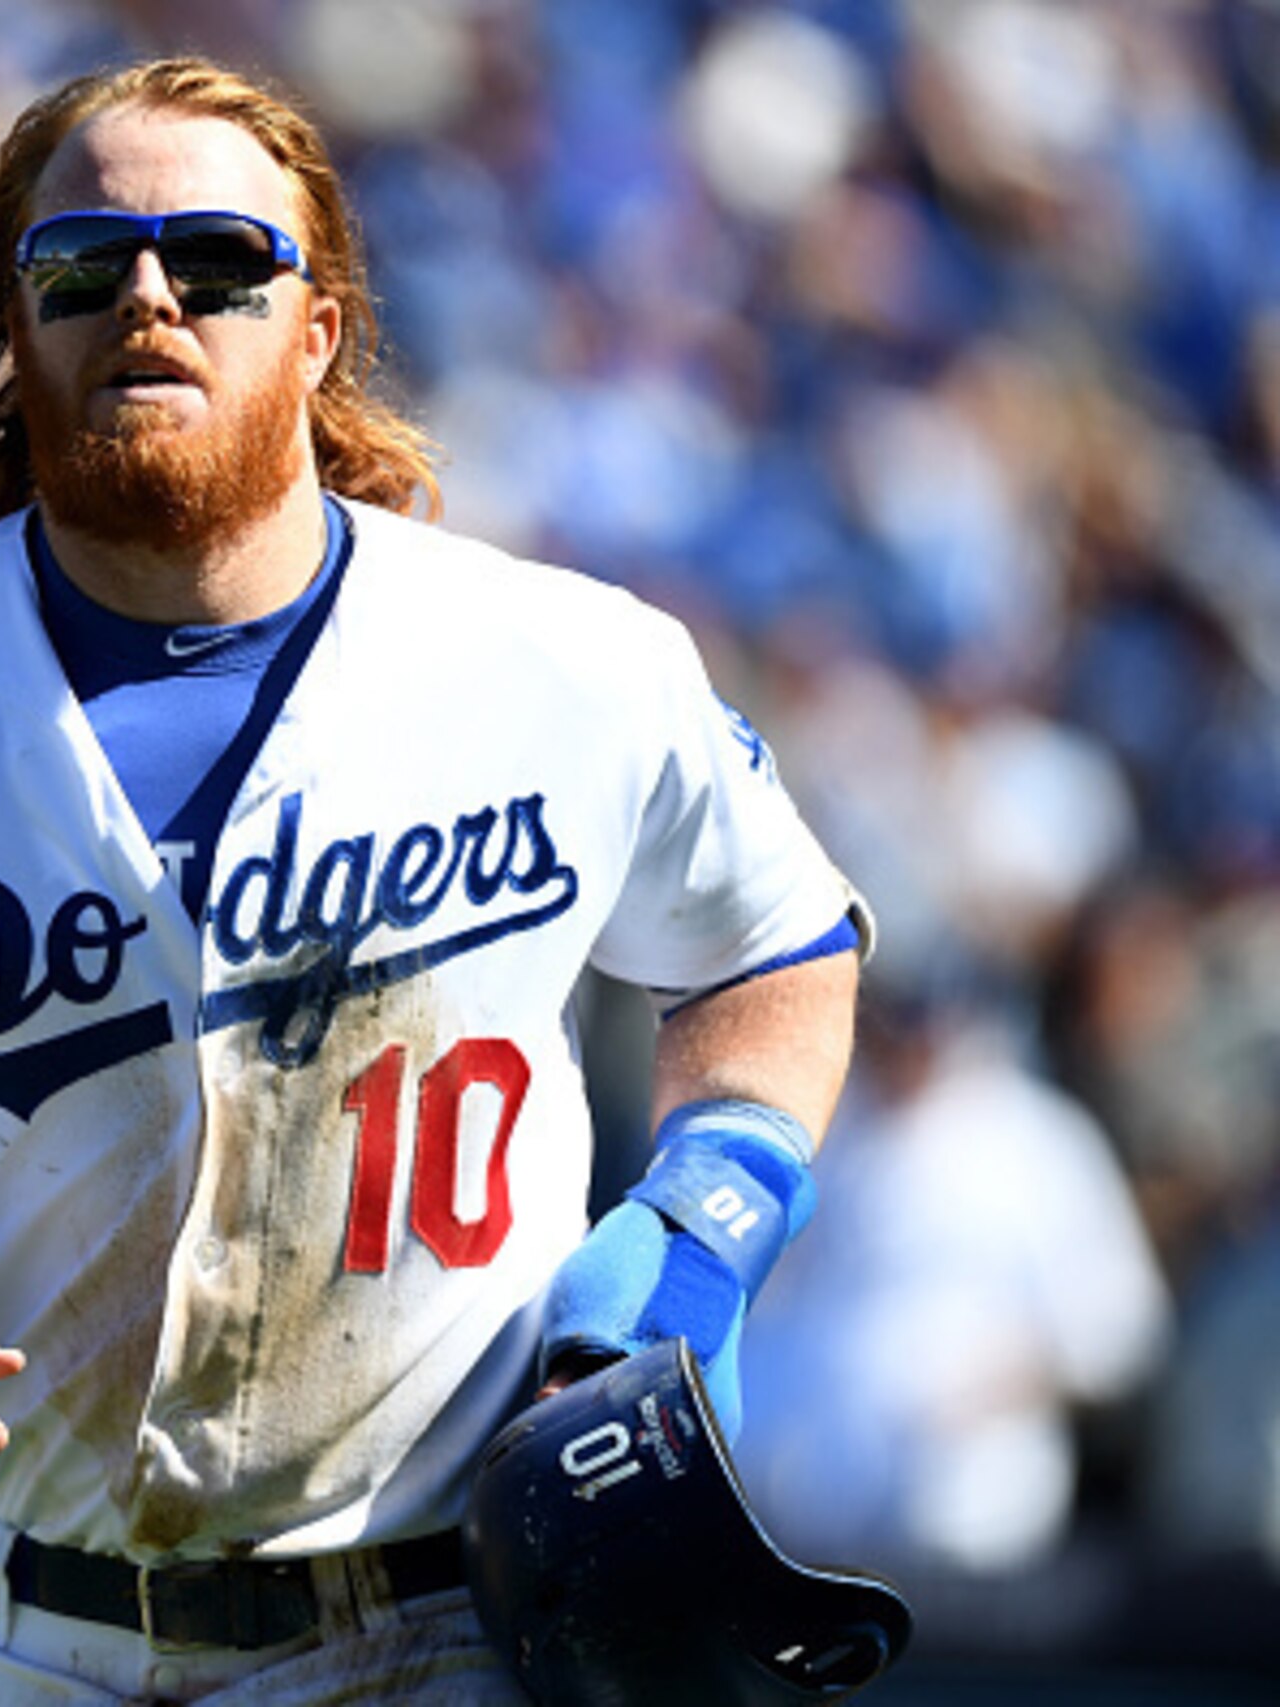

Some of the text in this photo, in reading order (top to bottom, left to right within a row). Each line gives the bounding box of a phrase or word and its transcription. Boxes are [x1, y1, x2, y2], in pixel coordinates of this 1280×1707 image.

[342, 1036, 532, 1273] 10
[702, 1185, 759, 1241] 10
[559, 1420, 643, 1501] 10
